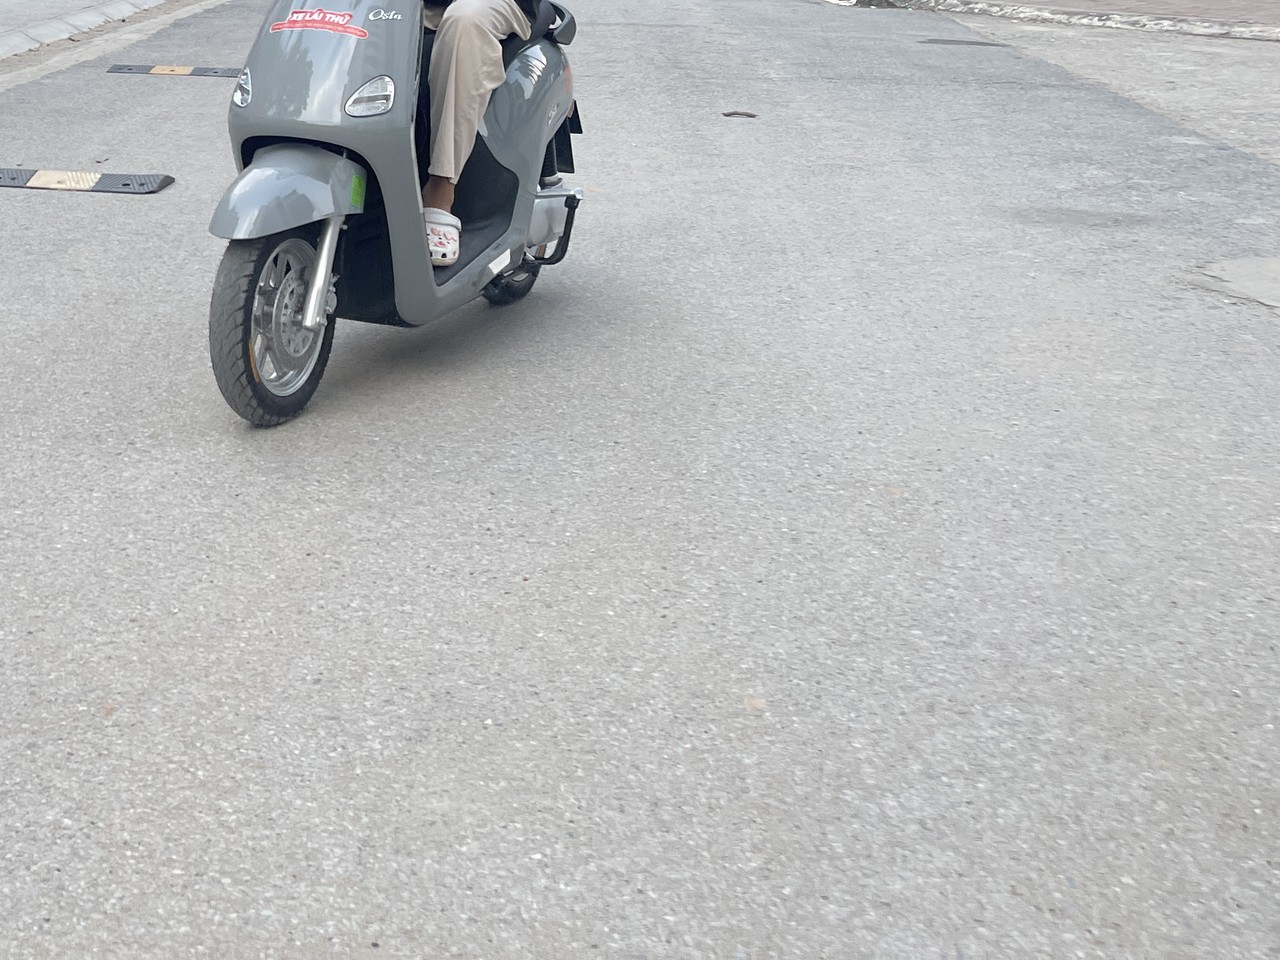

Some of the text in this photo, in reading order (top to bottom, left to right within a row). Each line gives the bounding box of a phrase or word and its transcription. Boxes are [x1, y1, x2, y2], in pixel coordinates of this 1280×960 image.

[290, 13, 305, 21] XE
[305, 10, 324, 21] LÁI
[368, 8, 404, 21] Osta
